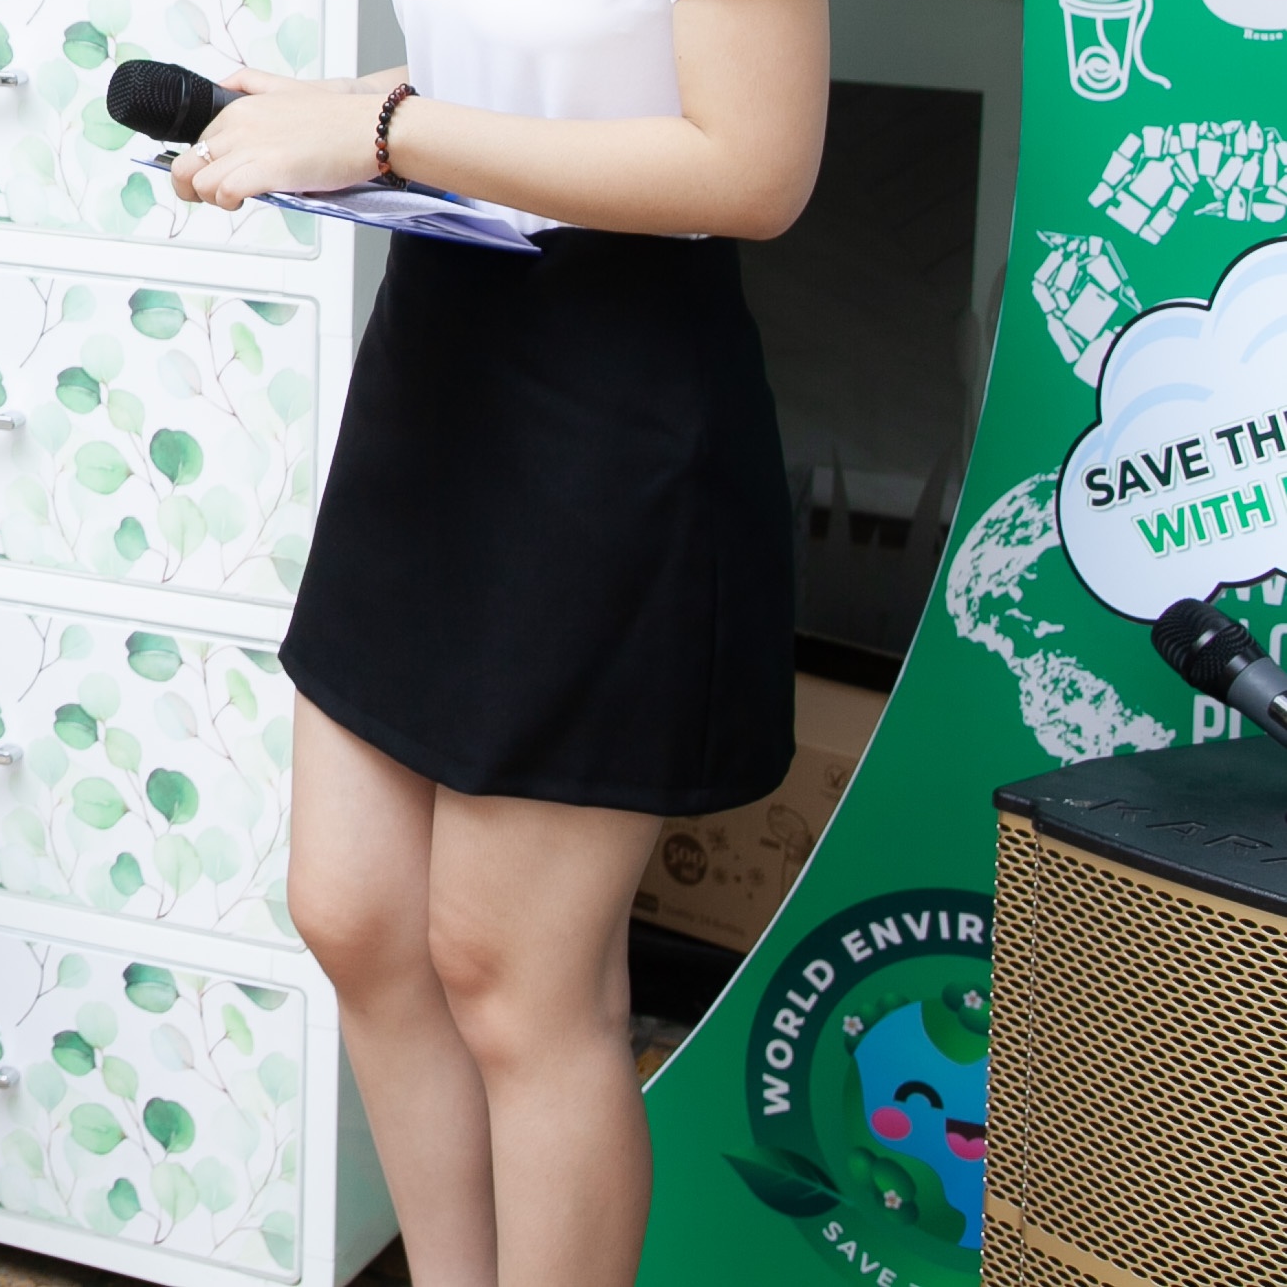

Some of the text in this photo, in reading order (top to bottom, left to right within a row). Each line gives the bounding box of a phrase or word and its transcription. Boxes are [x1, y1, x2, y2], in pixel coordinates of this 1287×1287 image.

[1242, 27, 1284, 41] Reuse
[1085, 437, 1211, 508] SAVE
[1214, 410, 1287, 465] TH
[1136, 484, 1273, 555] WITH
[761, 910, 995, 1117] WORLD ENVIR
[821, 1220, 898, 1287] SAVE
